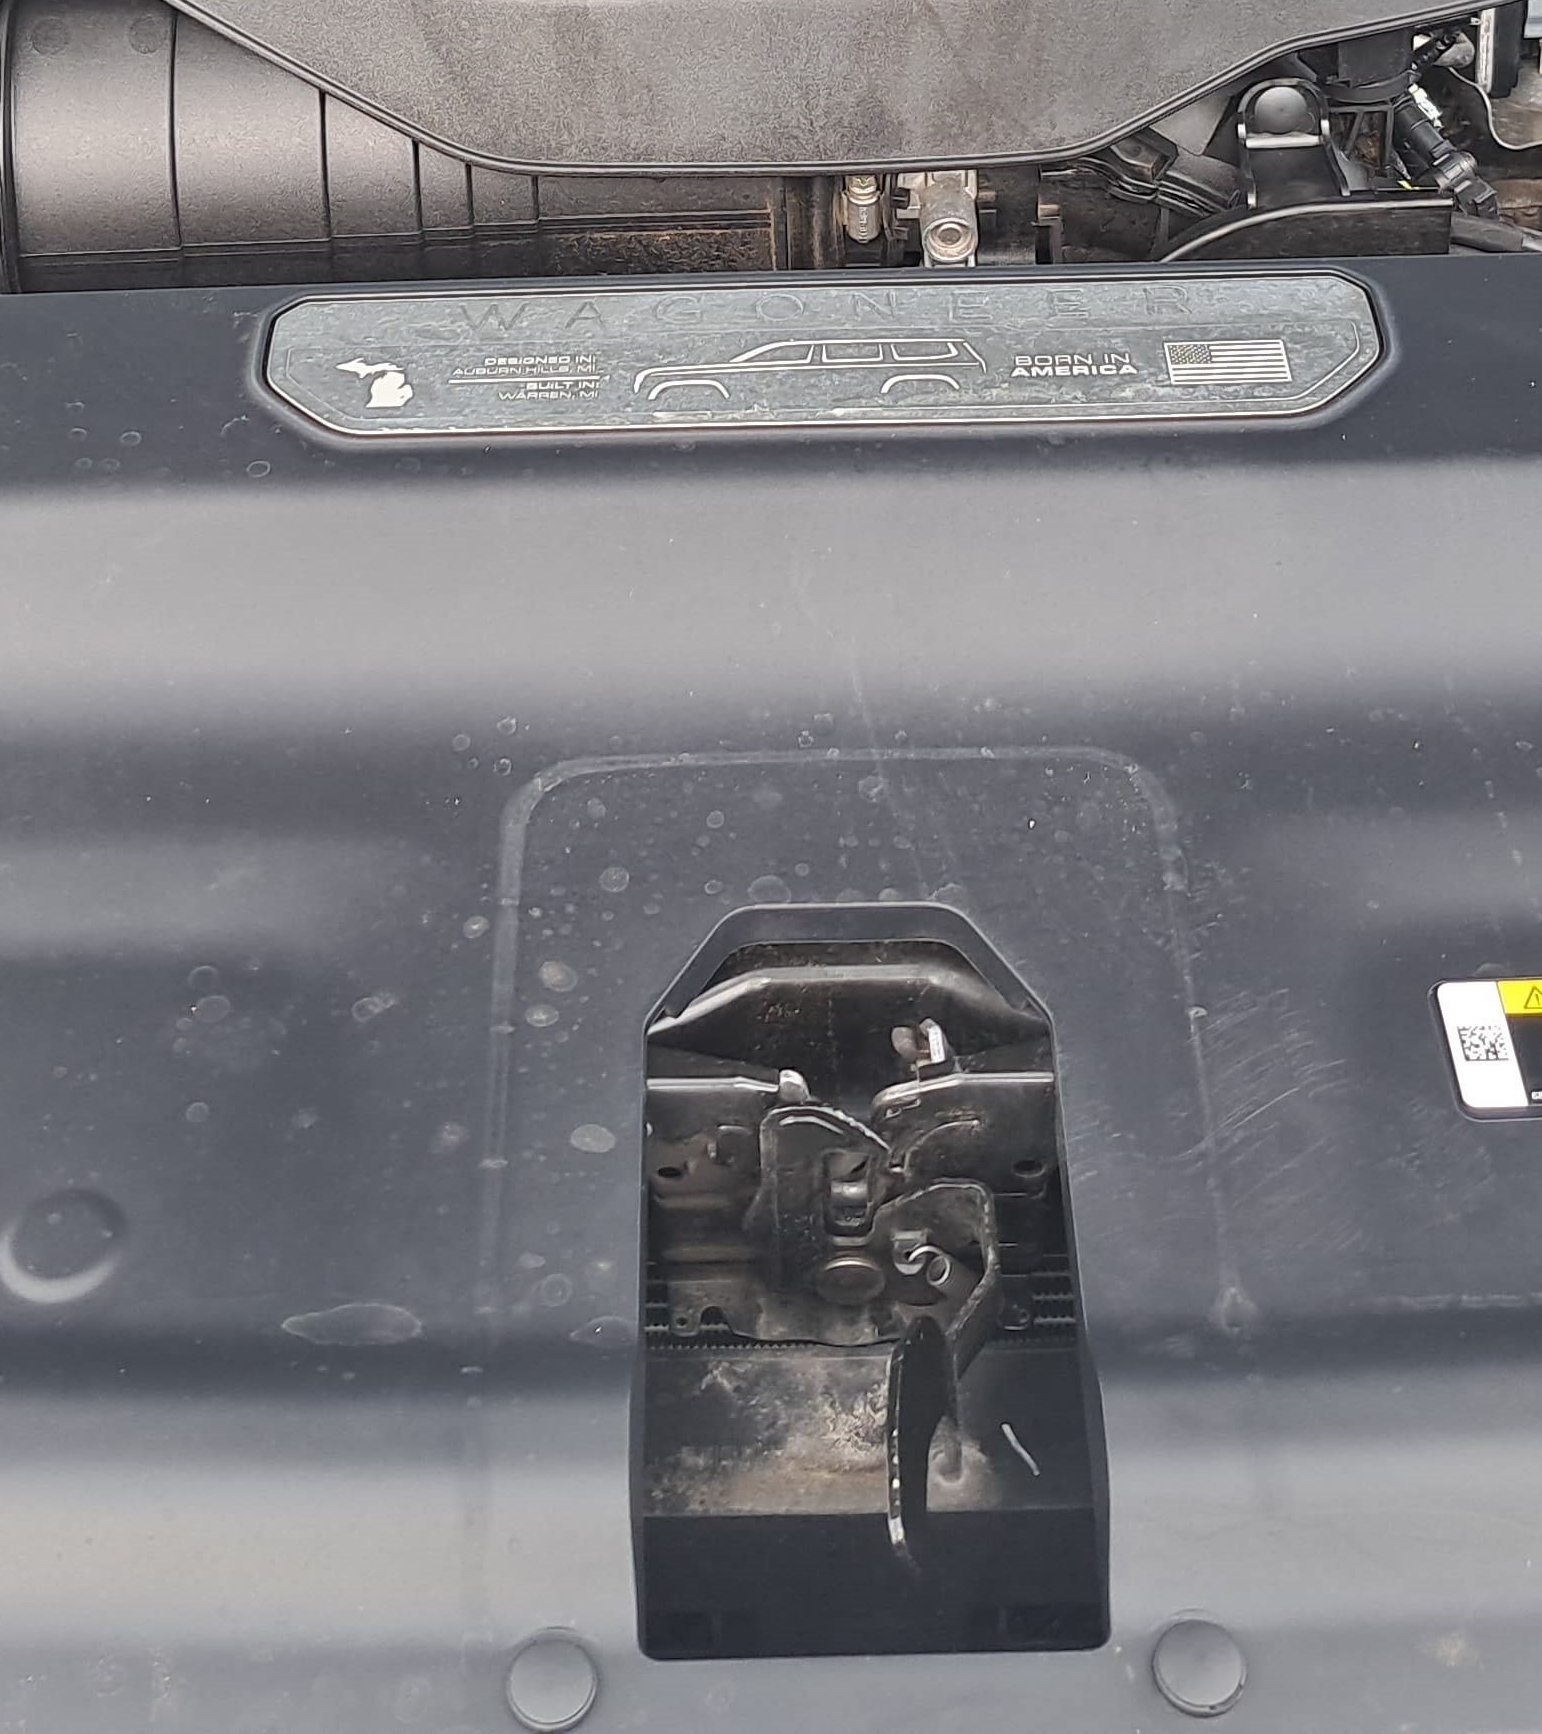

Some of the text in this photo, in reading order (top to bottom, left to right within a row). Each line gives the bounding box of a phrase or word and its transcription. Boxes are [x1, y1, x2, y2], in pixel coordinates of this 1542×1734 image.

[458, 285, 1192, 331] WAGONEER
[484, 355, 571, 366] DESIGNED
[1015, 352, 1131, 366] BORN IN
[452, 363, 596, 376] AUBURN HILLS, MI
[1010, 364, 1139, 378] AMERICA
[525, 381, 573, 390] BUILT
[498, 389, 599, 401] WARREN, MI
